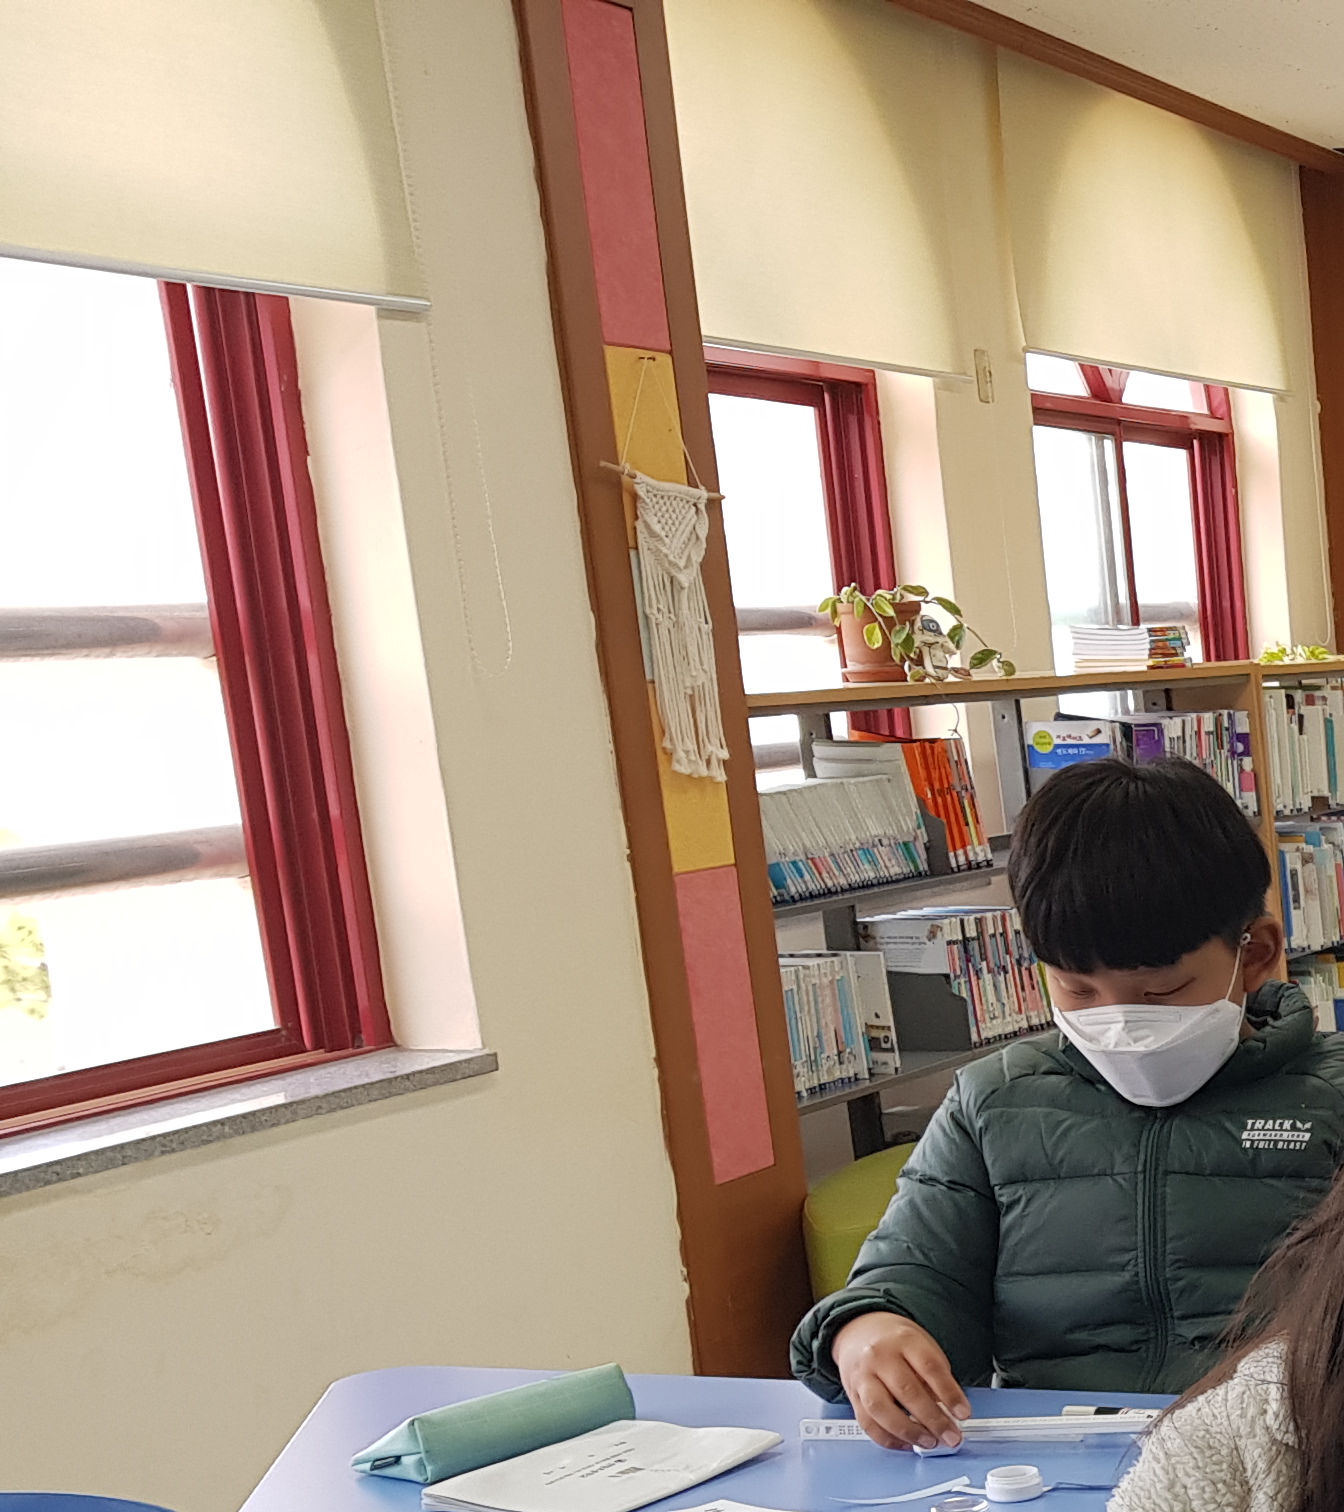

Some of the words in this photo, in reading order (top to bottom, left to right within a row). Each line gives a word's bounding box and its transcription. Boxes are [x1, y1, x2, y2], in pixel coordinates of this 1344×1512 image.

[1246, 1119, 1294, 1130] TRACK
[1253, 1141, 1275, 1149] FULL
[1277, 1142, 1307, 1150] BLAST
